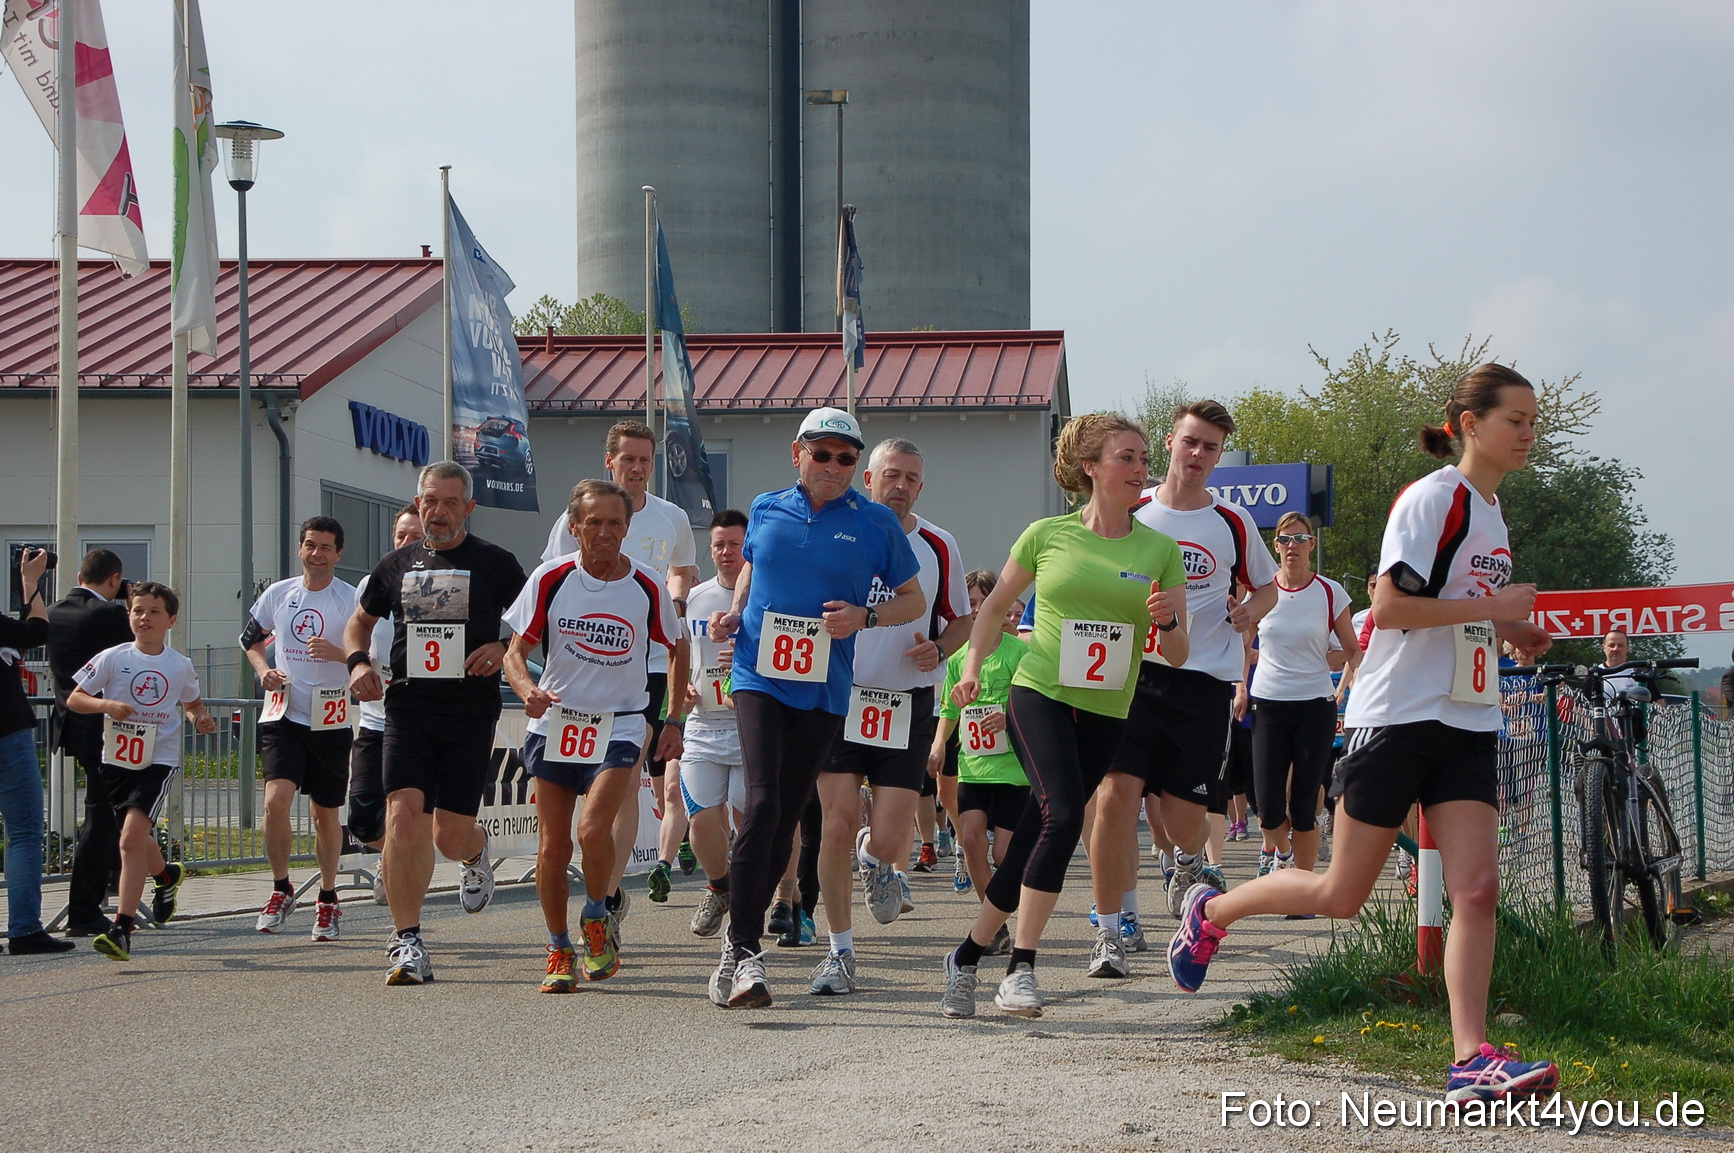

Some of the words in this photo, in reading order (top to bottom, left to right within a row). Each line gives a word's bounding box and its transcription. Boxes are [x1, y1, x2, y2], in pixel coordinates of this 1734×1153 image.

[348, 400, 430, 467] VOLVO
[1186, 582, 1211, 590] utohaus
[416, 626, 443, 634] MEYER
[558, 618, 625, 637] GERHART
[773, 616, 805, 629] MEYER
[773, 624, 805, 634] WERBUNG
[1073, 623, 1108, 633] MEYER
[1464, 625, 1488, 637] MEYER
[559, 629, 587, 638] Autohaus
[586, 633, 629, 649] JÄNIG
[1073, 631, 1108, 639] WERBUNG
[1464, 635, 1488, 645] WERBUNG
[424, 640, 440, 672] 3
[564, 643, 576, 655] Das
[575, 652, 605, 667] sportliche
[605, 657, 633, 667] Autohaus
[772, 634, 814, 675] 83
[1086, 642, 1107, 682] 2
[1472, 646, 1487, 694] 8
[712, 679, 723, 706] 1
[859, 689, 890, 701] MEYER
[267, 692, 285, 717] 24
[859, 697, 890, 706] WERBUNG
[323, 698, 346, 726] 23
[560, 714, 590, 723] WERBUNG
[112, 720, 136, 730] MEYER
[860, 705, 893, 741] 81
[560, 724, 598, 758] 66
[968, 721, 996, 751] 35
[115, 733, 144, 765] 20
